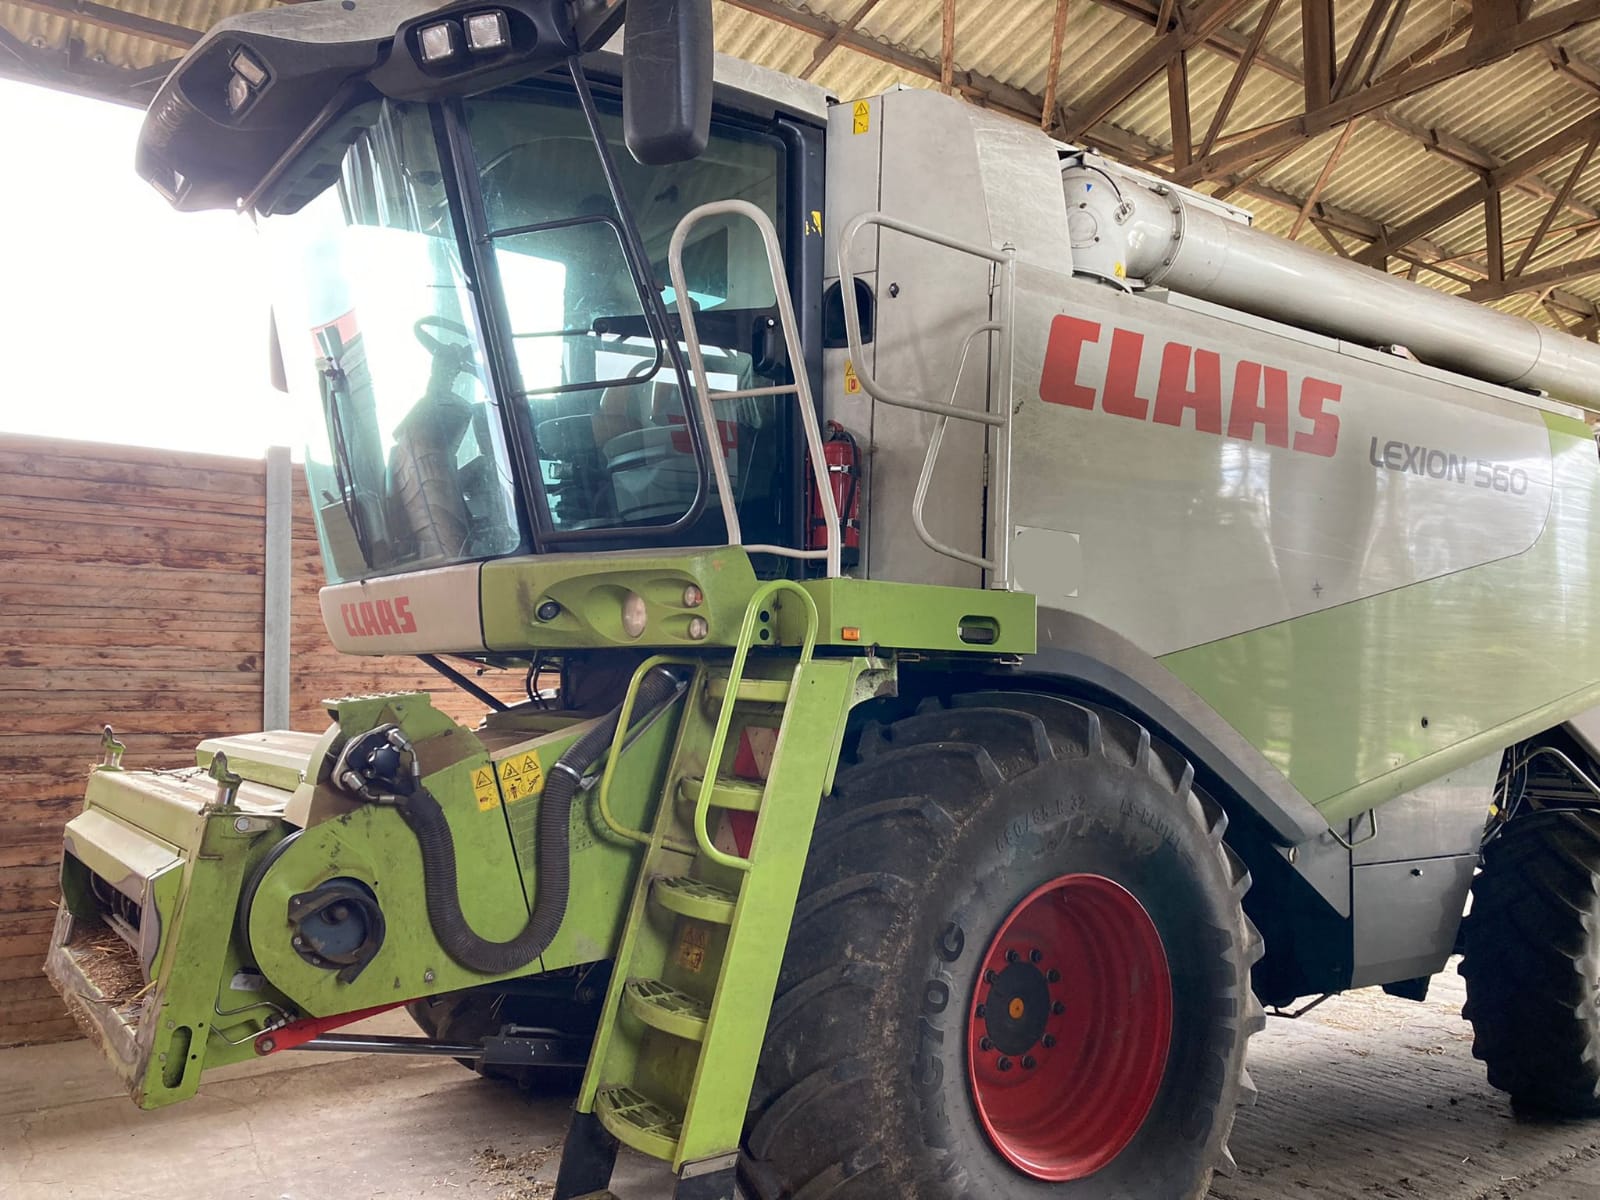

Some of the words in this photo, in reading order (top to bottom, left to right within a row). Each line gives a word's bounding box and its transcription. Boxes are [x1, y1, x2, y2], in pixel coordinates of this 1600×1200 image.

[1039, 314, 1342, 457] CLAAS
[1370, 436, 1466, 483] LEXION
[1474, 459, 1528, 495] 560
[341, 596, 417, 637] CLAAS
